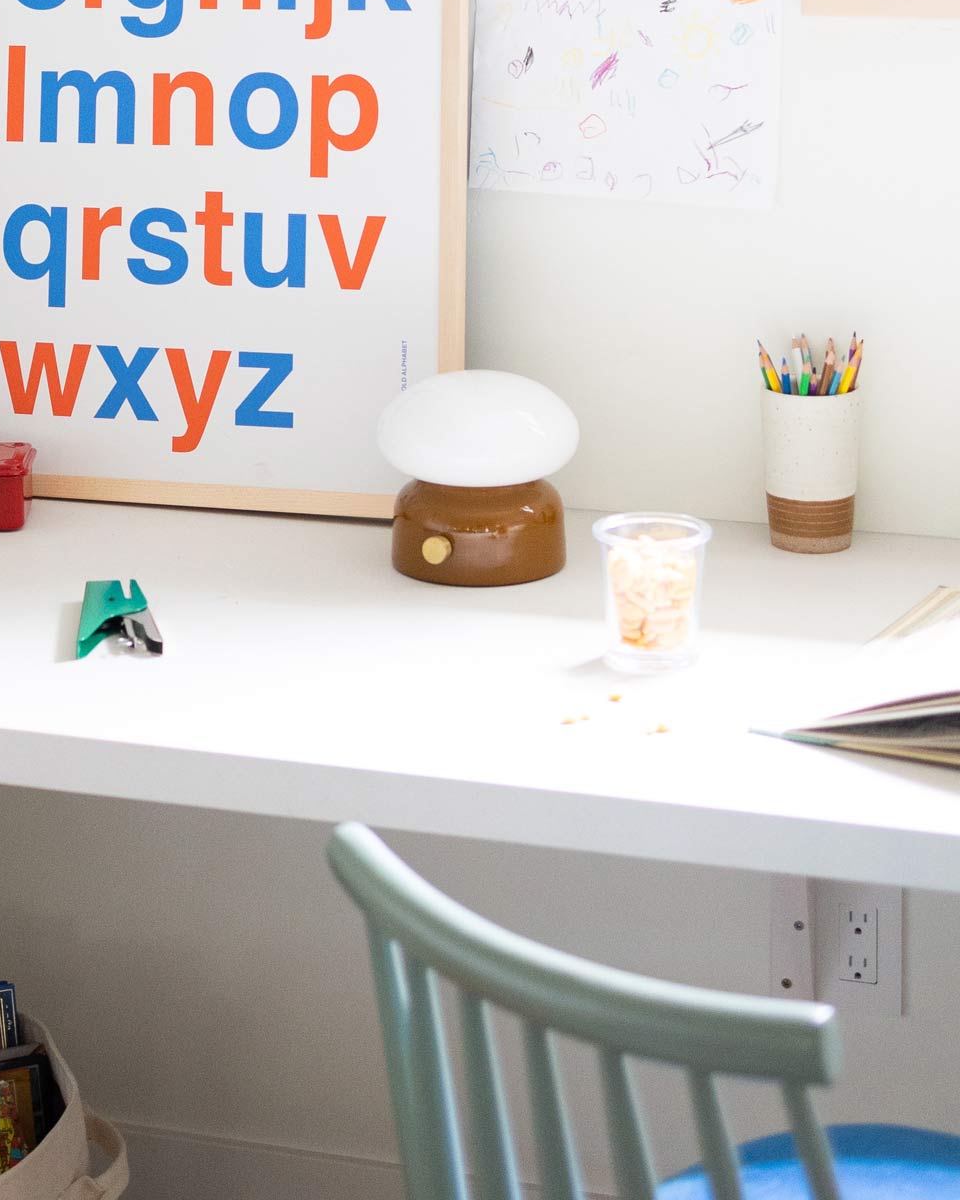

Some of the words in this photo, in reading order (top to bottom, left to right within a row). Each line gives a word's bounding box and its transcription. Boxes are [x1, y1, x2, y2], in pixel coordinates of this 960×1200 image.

[7, 46, 379, 177] lmnop
[4, 192, 386, 308] qrstuv
[0, 341, 293, 455] wxyz
